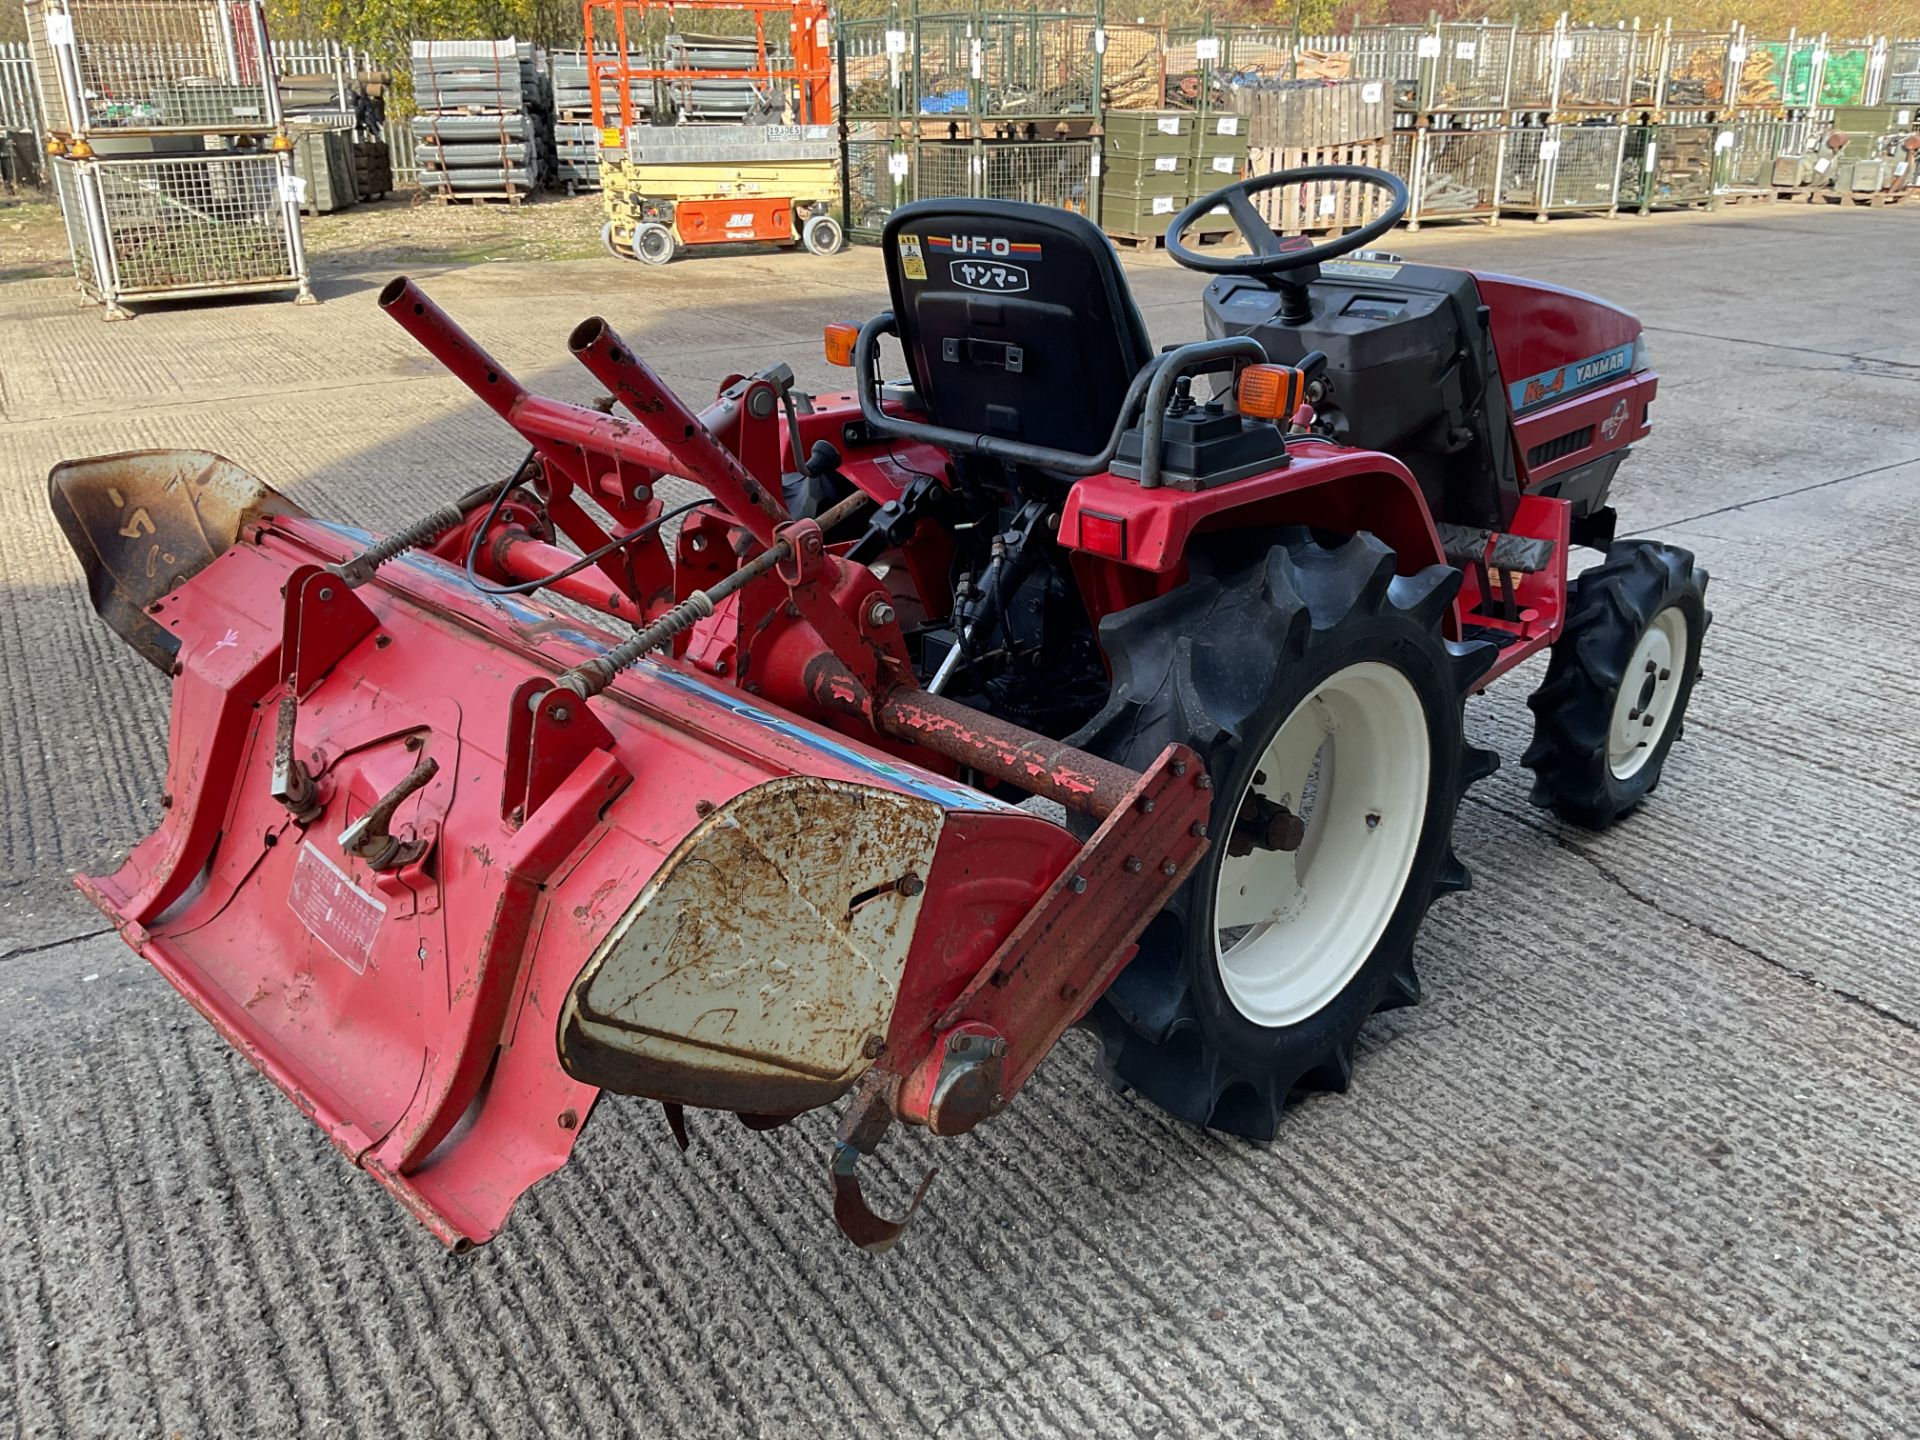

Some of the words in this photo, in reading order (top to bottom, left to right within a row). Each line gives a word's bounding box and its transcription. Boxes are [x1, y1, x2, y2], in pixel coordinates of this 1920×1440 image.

[768, 126, 800, 134] 1930ES
[726, 214, 755, 227] JLG
[951, 234, 1011, 256] UFO
[961, 263, 1018, 288] ヤンマー
[1522, 368, 1565, 405] Ke-4
[1576, 351, 1624, 385] YANMAR
